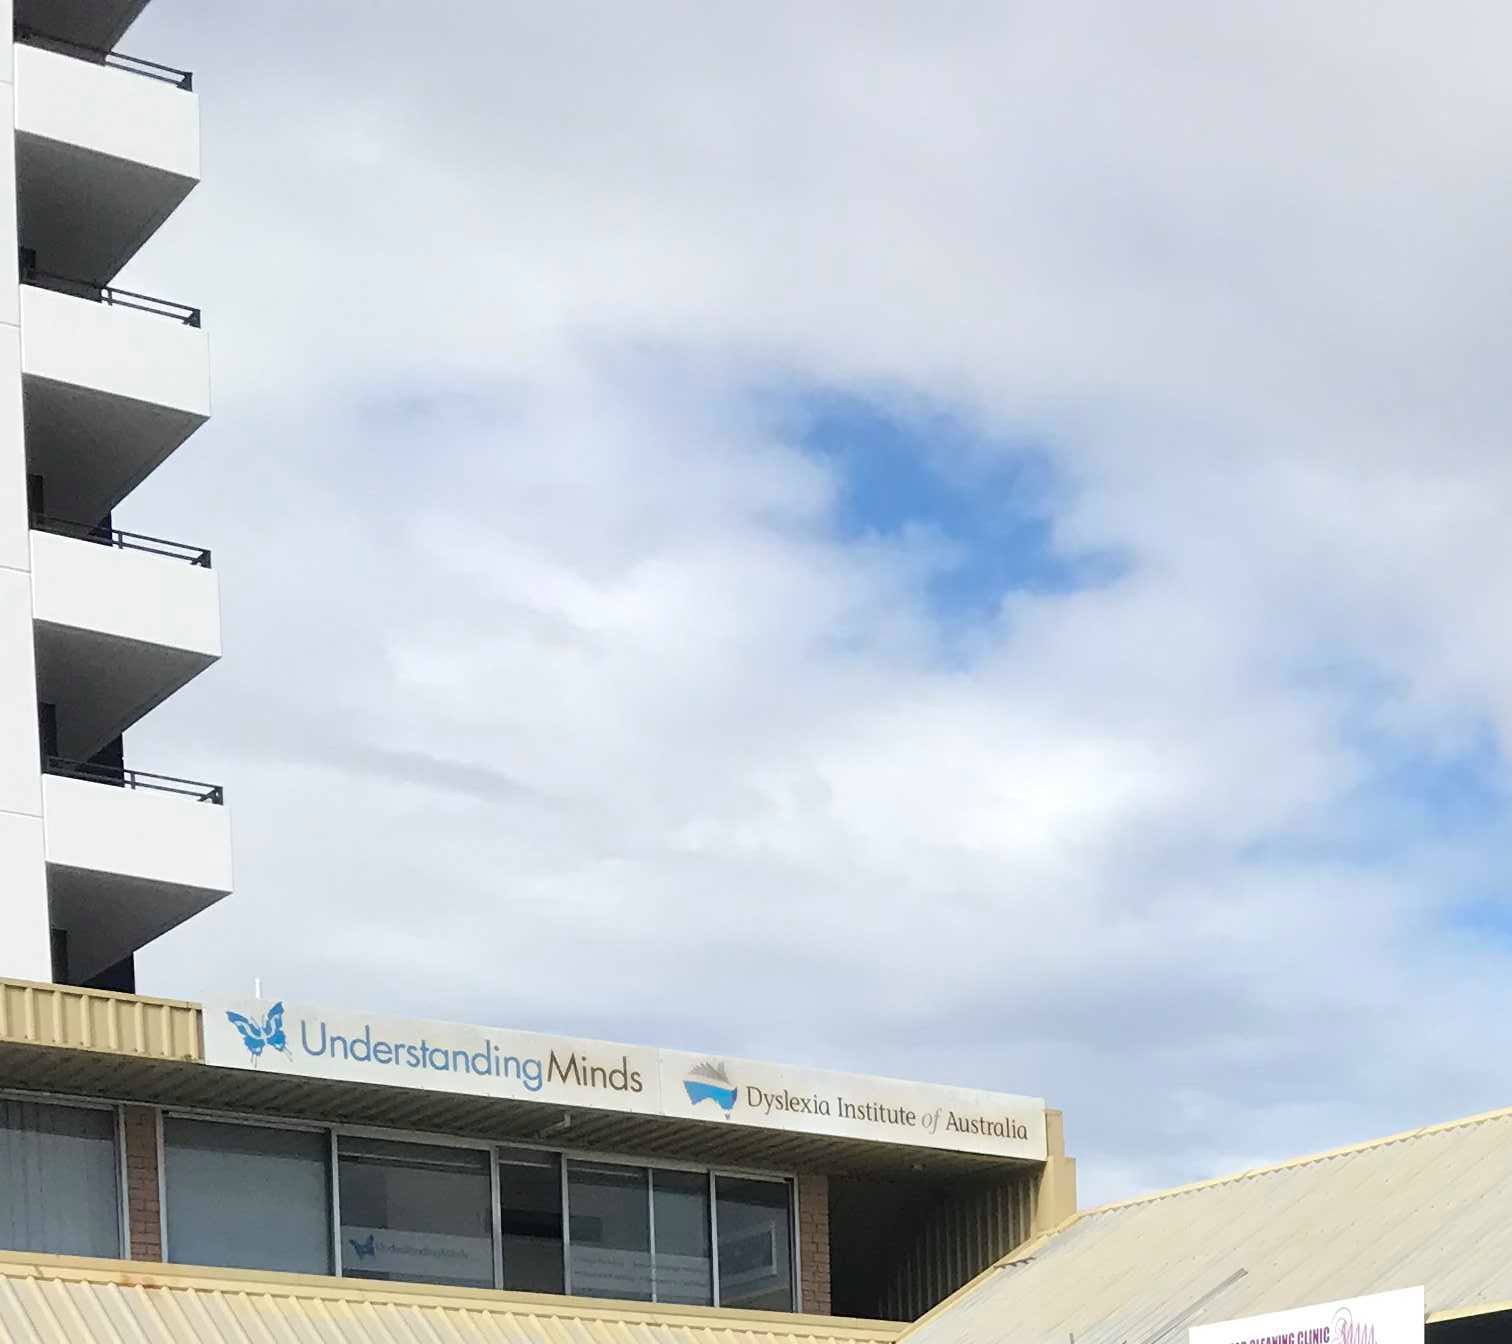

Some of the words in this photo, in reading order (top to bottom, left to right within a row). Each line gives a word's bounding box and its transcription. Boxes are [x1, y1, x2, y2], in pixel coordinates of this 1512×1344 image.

[300, 1019, 544, 1092] Understanding
[547, 1049, 643, 1093] Minds
[745, 1085, 831, 1116] Dyslexia
[837, 1096, 917, 1126] Institute
[921, 1107, 943, 1134] of
[945, 1110, 1029, 1141] Australia
